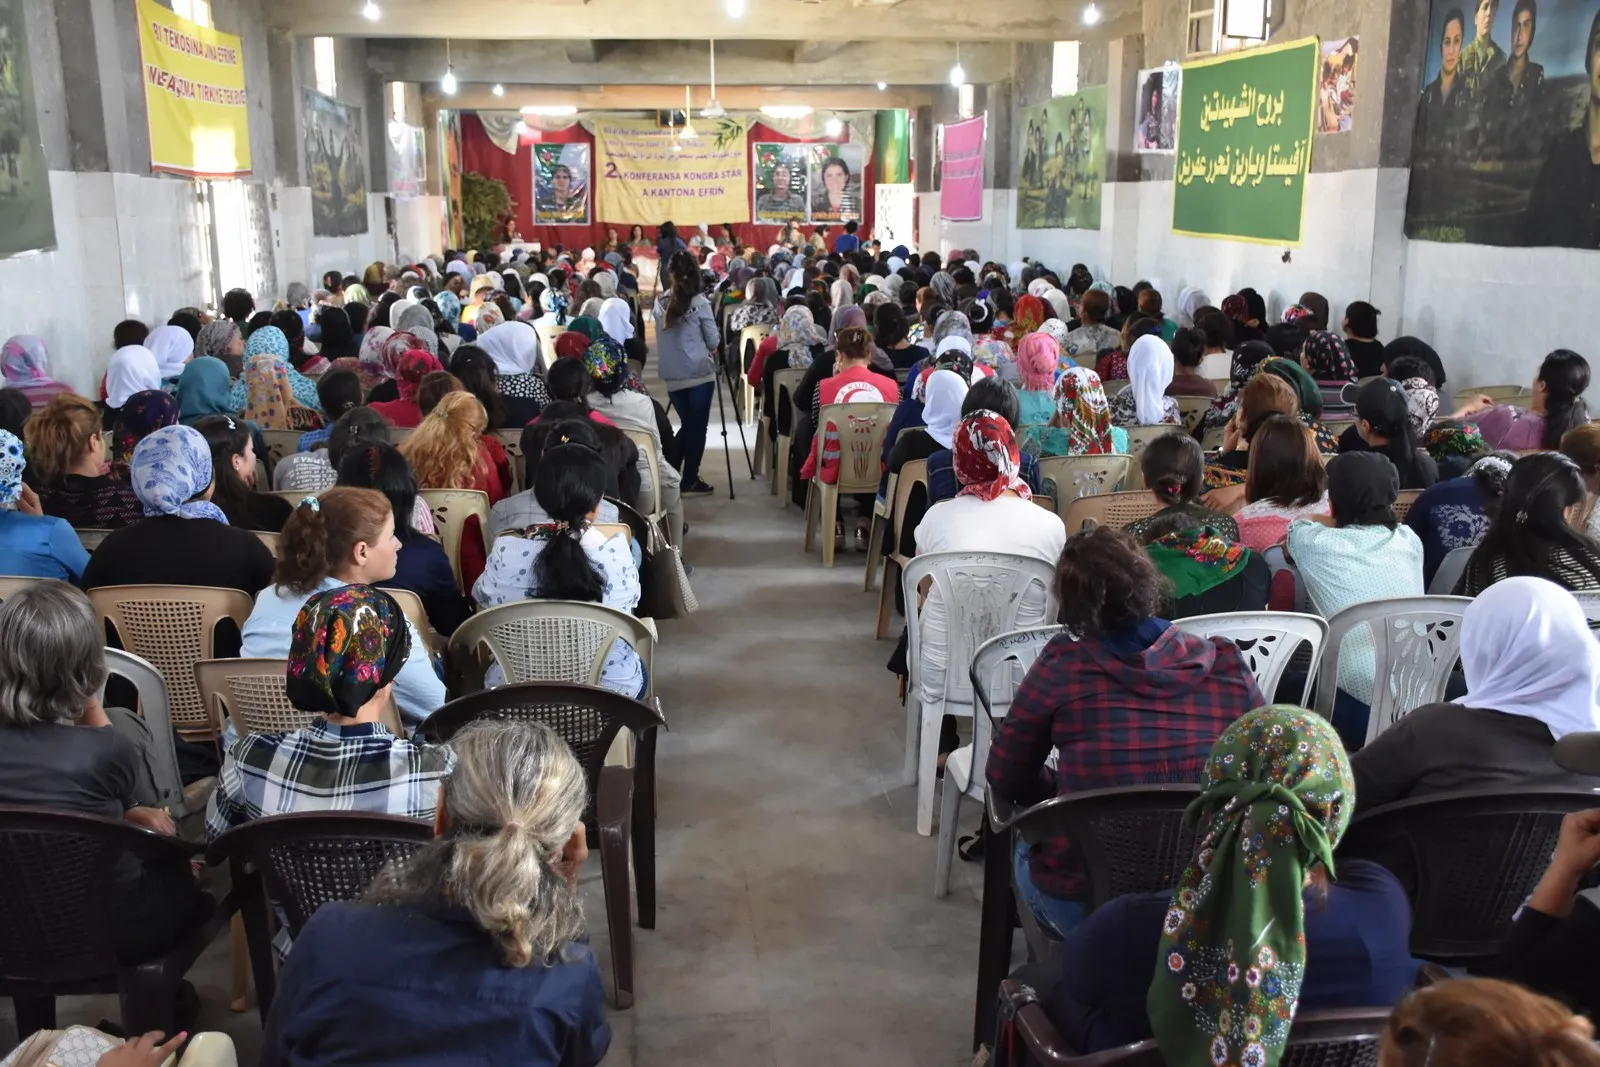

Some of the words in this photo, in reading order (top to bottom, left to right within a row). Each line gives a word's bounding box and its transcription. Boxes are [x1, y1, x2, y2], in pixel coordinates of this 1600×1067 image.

[1200, 82, 1256, 132] الشهيدتين
[1256, 89, 1284, 126] بروح
[623, 171, 681, 181] KONFERANSA
[683, 171, 719, 180] KONGRA
[720, 169, 742, 178] STAR
[1177, 146, 1206, 186] عفرين
[1265, 139, 1307, 187] آفيستا
[642, 189, 649, 197] A
[651, 188, 695, 197] KANTONA
